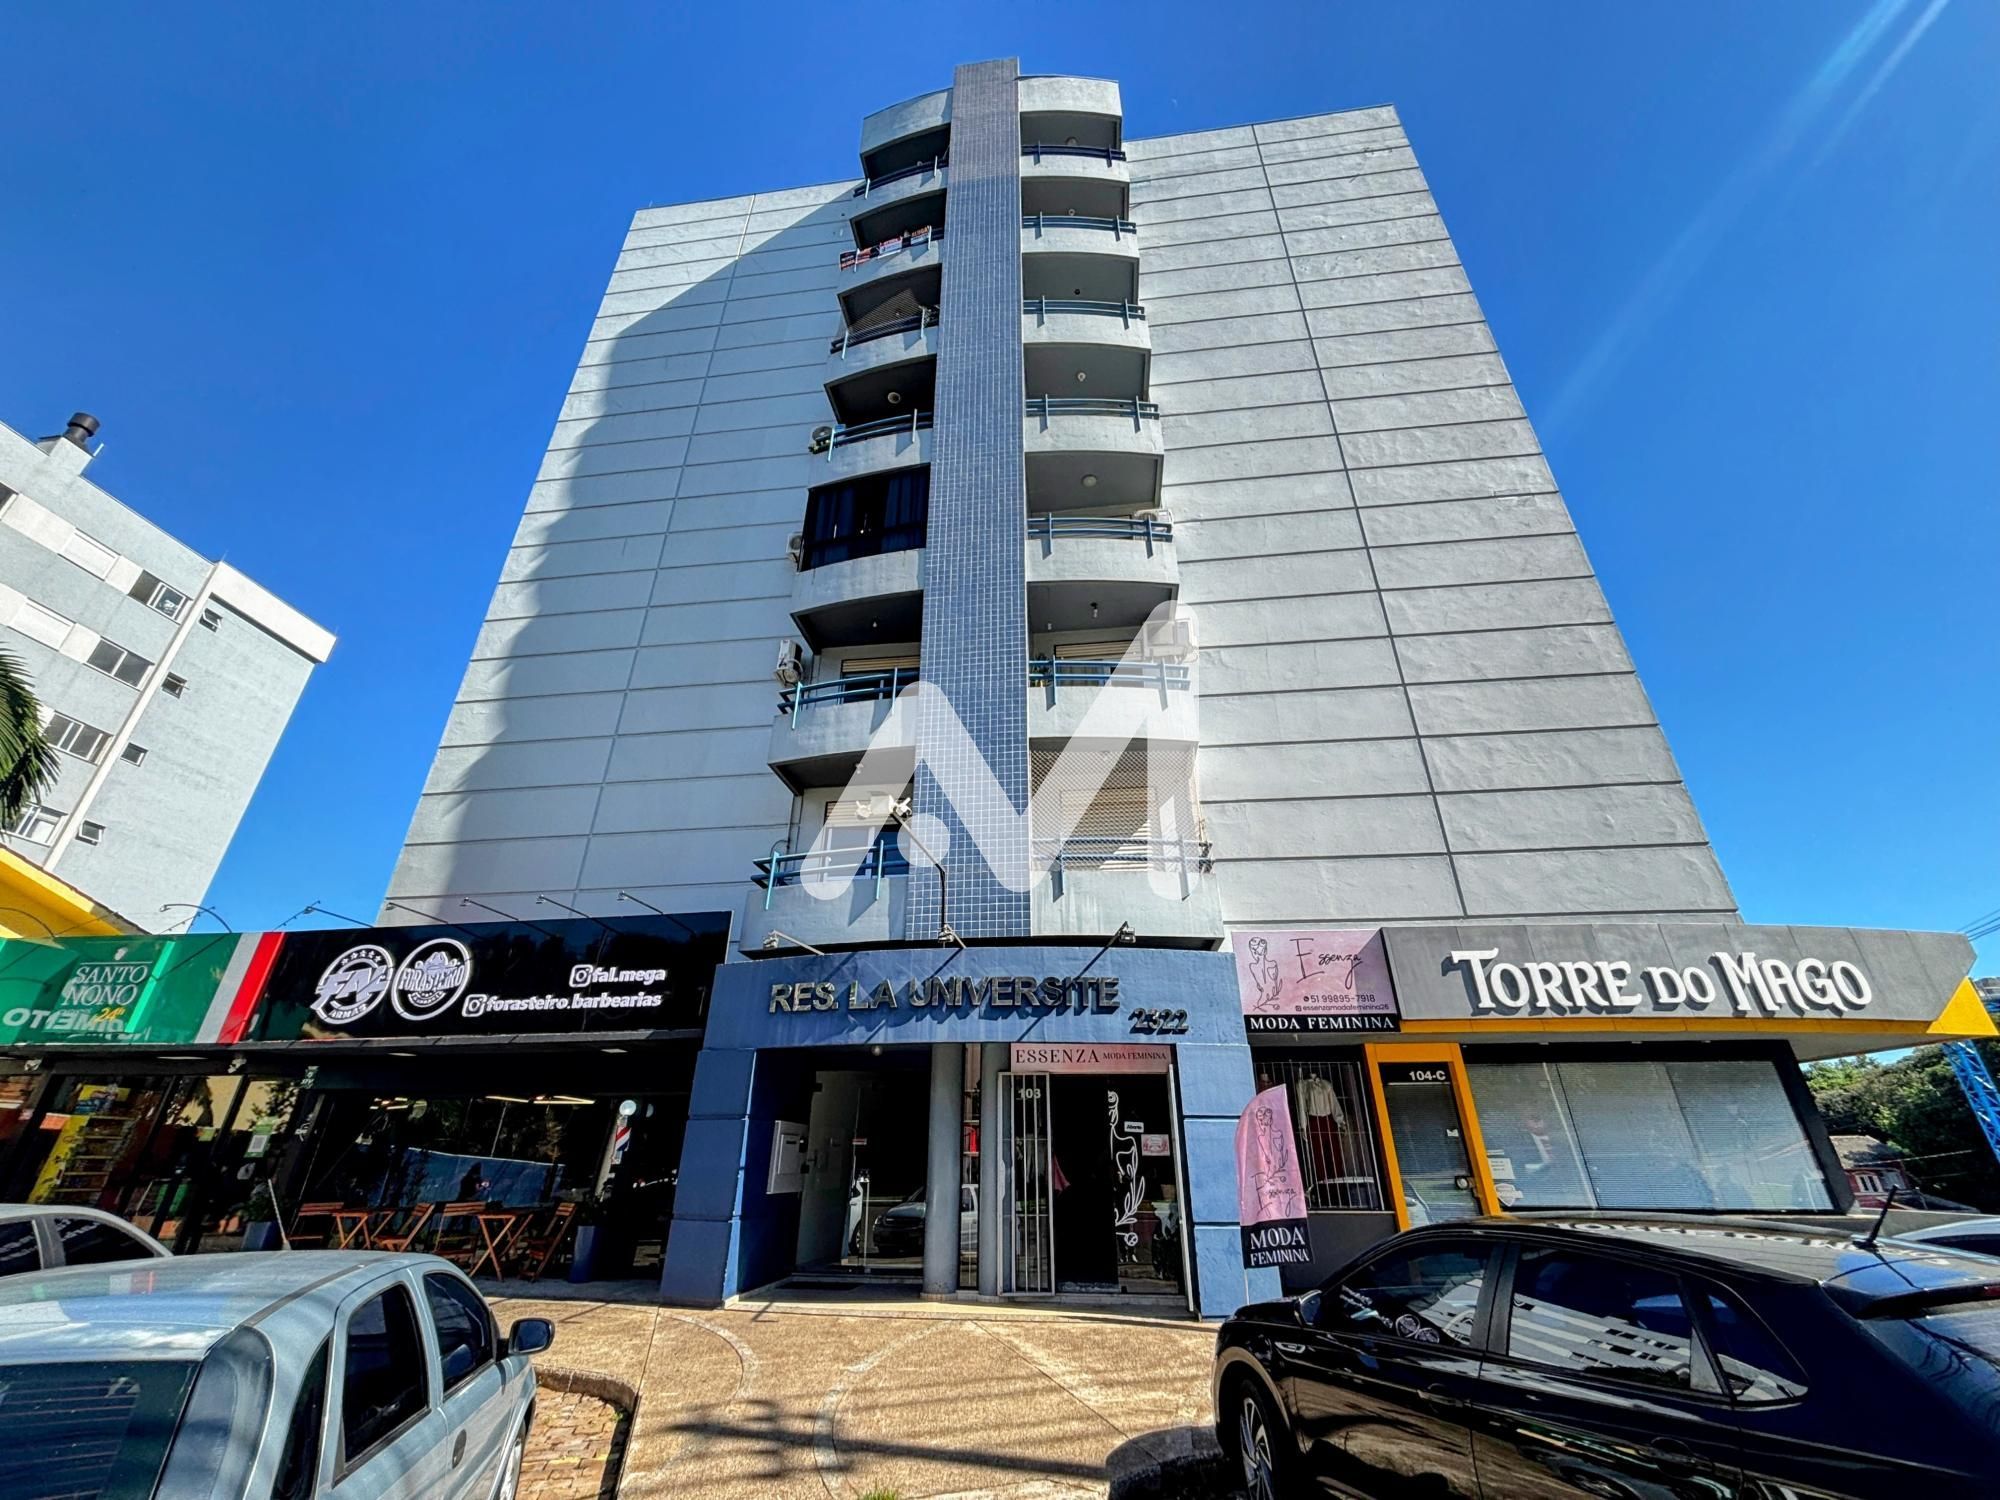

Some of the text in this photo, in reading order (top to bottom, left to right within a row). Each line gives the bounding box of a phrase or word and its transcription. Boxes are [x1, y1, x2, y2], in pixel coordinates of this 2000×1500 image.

[75, 965, 148, 985] SANTO
[399, 964, 465, 991] FORASTEIRO
[592, 966, 666, 985] fal.mega
[1450, 947, 1872, 1012] TORRE DO MAGO
[61, 984, 138, 1006] NONO
[486, 992, 662, 1012] forasteiro.barbearias
[768, 975, 1121, 1013] RES. LA UNIVERSITE
[1311, 994, 1320, 1004] 51
[1130, 1007, 1189, 1031] 2322
[1250, 1016, 1395, 1030] MODA FEMININA
[1015, 1049, 1167, 1064] ESSENZA MODA FEMININA
[1408, 1070, 1446, 1081] 104-C
[1018, 1088, 1041, 1099] 103
[1250, 1226, 1306, 1250] MODA
[1250, 1248, 1310, 1266] FEMININA
